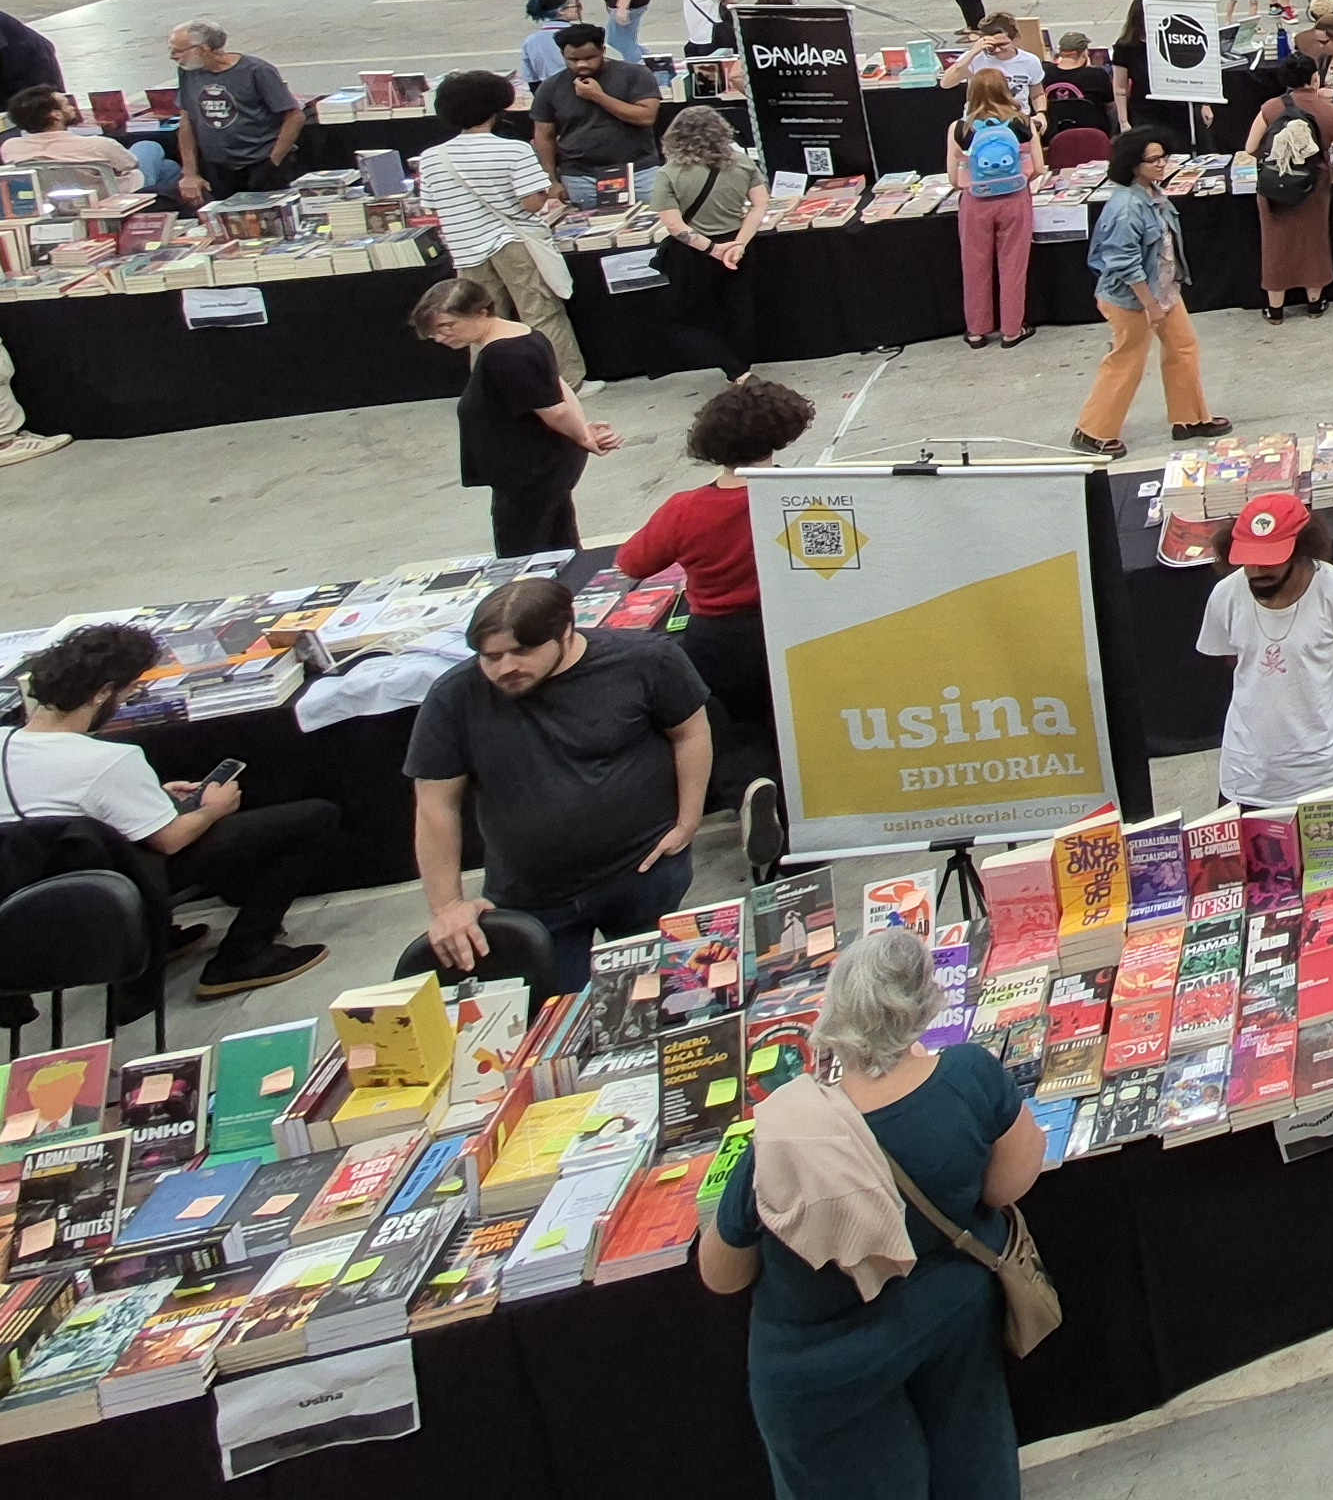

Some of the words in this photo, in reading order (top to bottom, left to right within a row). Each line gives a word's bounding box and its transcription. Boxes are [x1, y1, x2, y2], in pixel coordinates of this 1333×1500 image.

[1168, 34, 1205, 45] ISKRA
[781, 496, 822, 507] SCAN
[827, 496, 854, 506] ME!
[841, 686, 1077, 750] usina
[899, 753, 1084, 792] EDITORIAL
[883, 801, 1088, 833] usinaeditorial.com.br
[1188, 822, 1239, 848] DESEJO
[1185, 936, 1238, 956] HAMAS
[983, 978, 997, 987] O
[1122, 1038, 1164, 1056] ABC
[663, 1071, 700, 1088] SOCIAL
[378, 1208, 440, 1234] DRO
[369, 1224, 423, 1249] GAS
